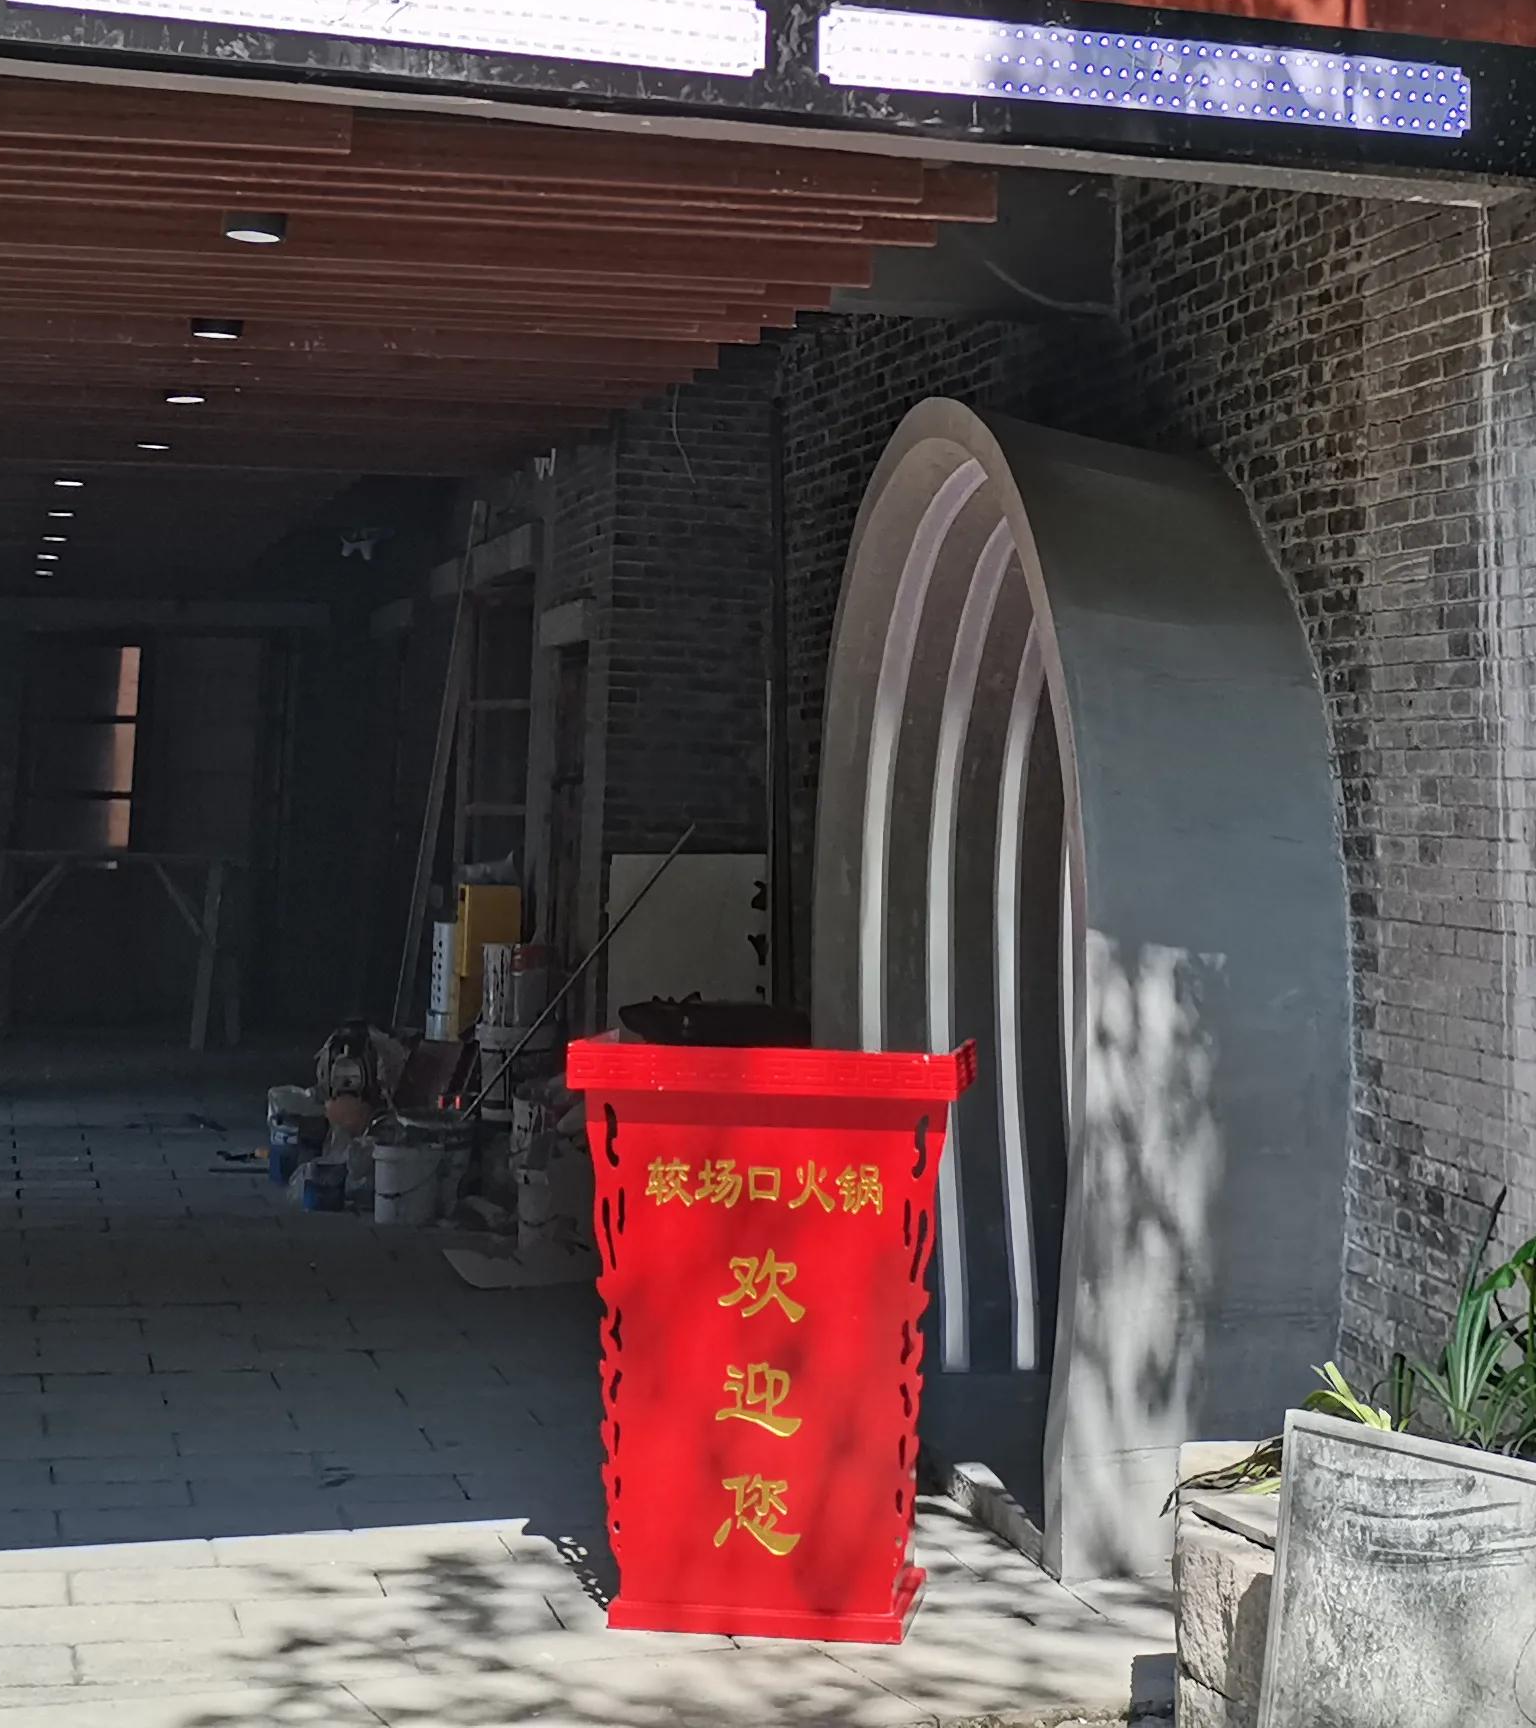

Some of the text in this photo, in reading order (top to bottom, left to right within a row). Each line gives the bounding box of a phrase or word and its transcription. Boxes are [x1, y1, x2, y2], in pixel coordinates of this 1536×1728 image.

[645, 1156, 884, 1215] 较场口火锅
[714, 1248, 806, 1556] 欢迎您
